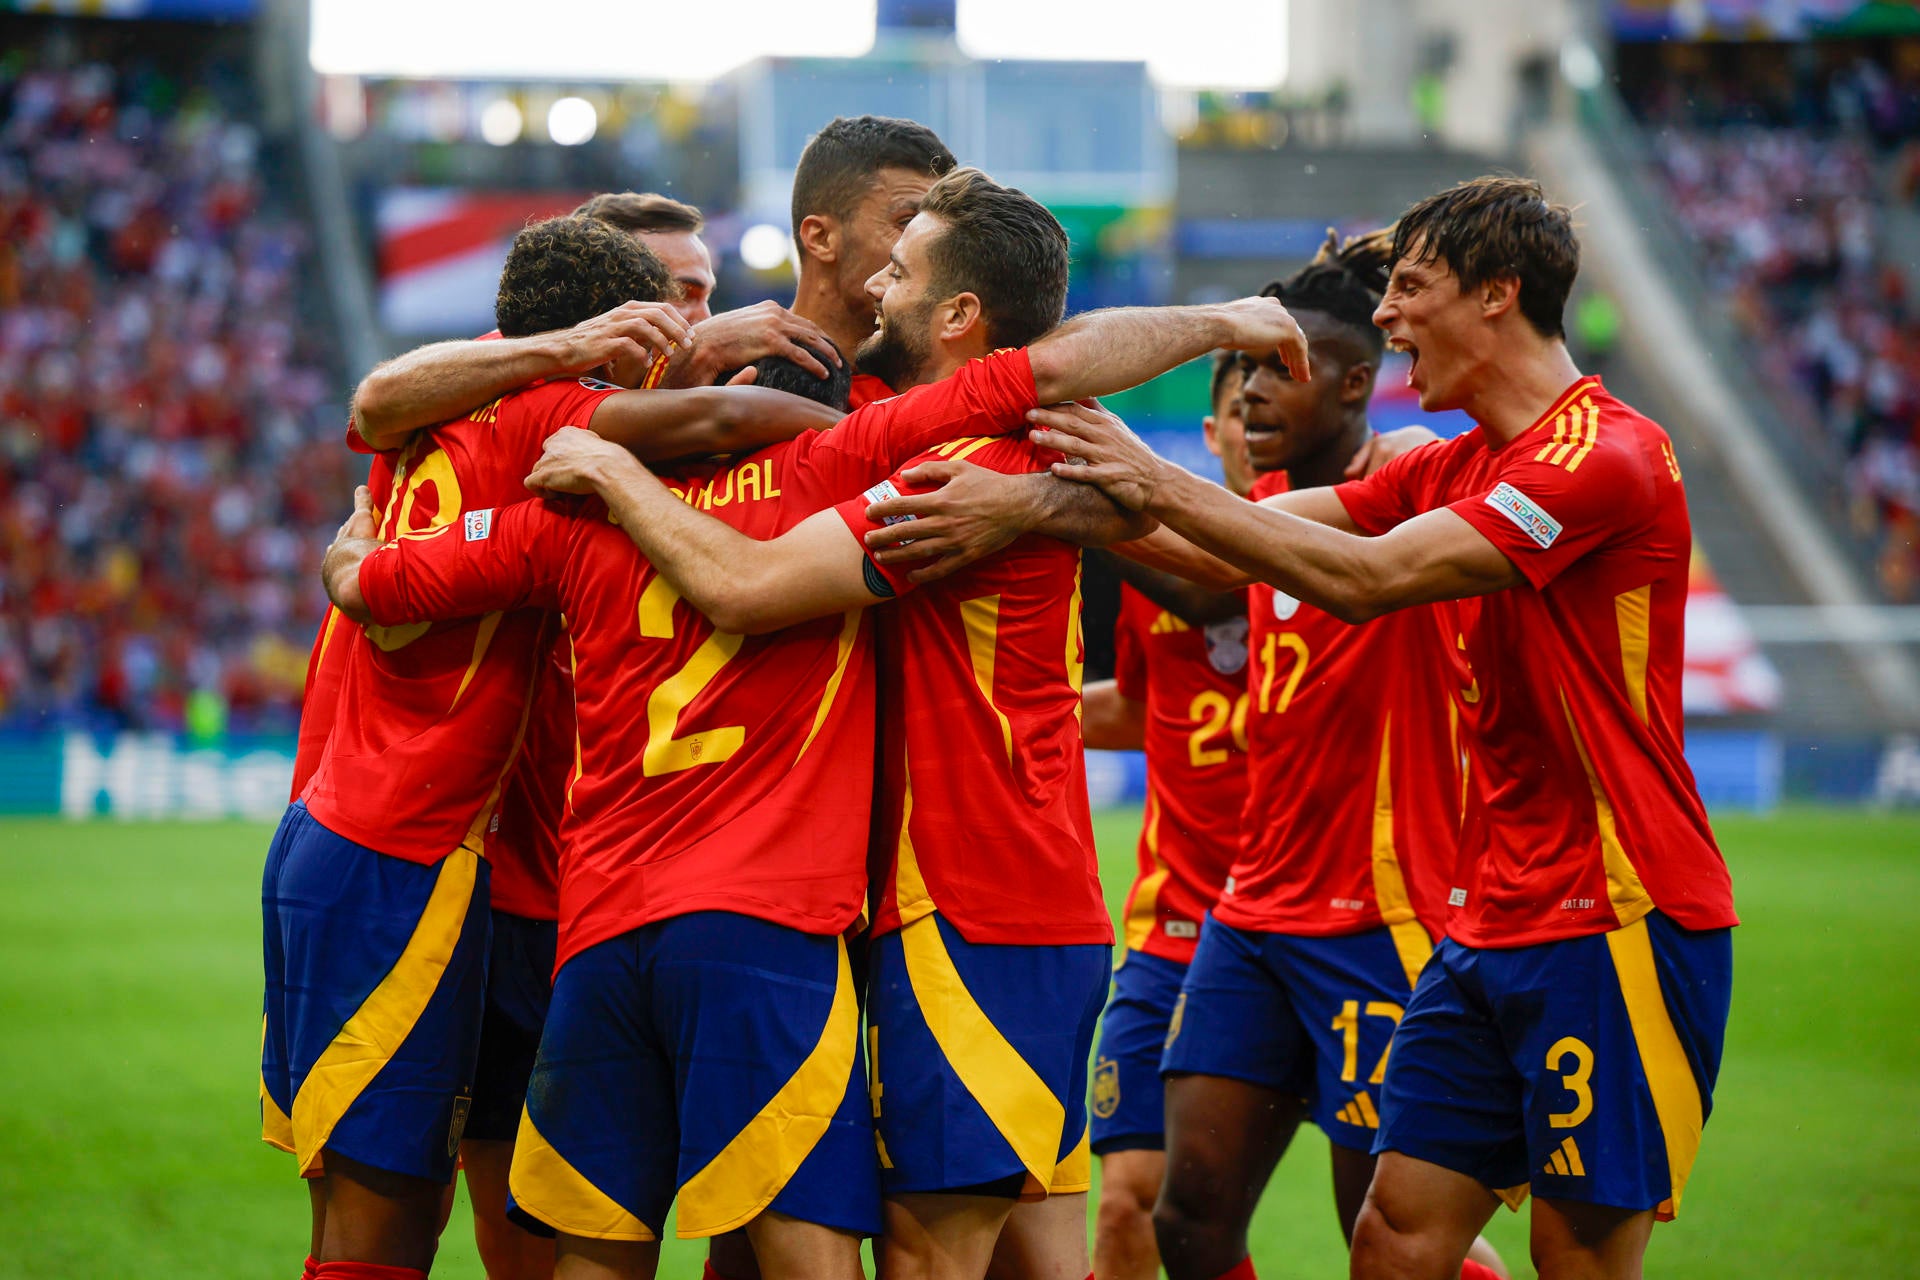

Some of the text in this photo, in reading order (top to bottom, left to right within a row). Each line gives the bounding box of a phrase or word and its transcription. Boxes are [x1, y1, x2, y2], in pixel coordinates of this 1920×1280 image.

[1493, 489, 1557, 541] FOUNDATION
[638, 572, 746, 778] 2
[1259, 632, 1310, 714] 17
[1331, 1000, 1405, 1084] 17
[1546, 1036, 1595, 1128] 3
